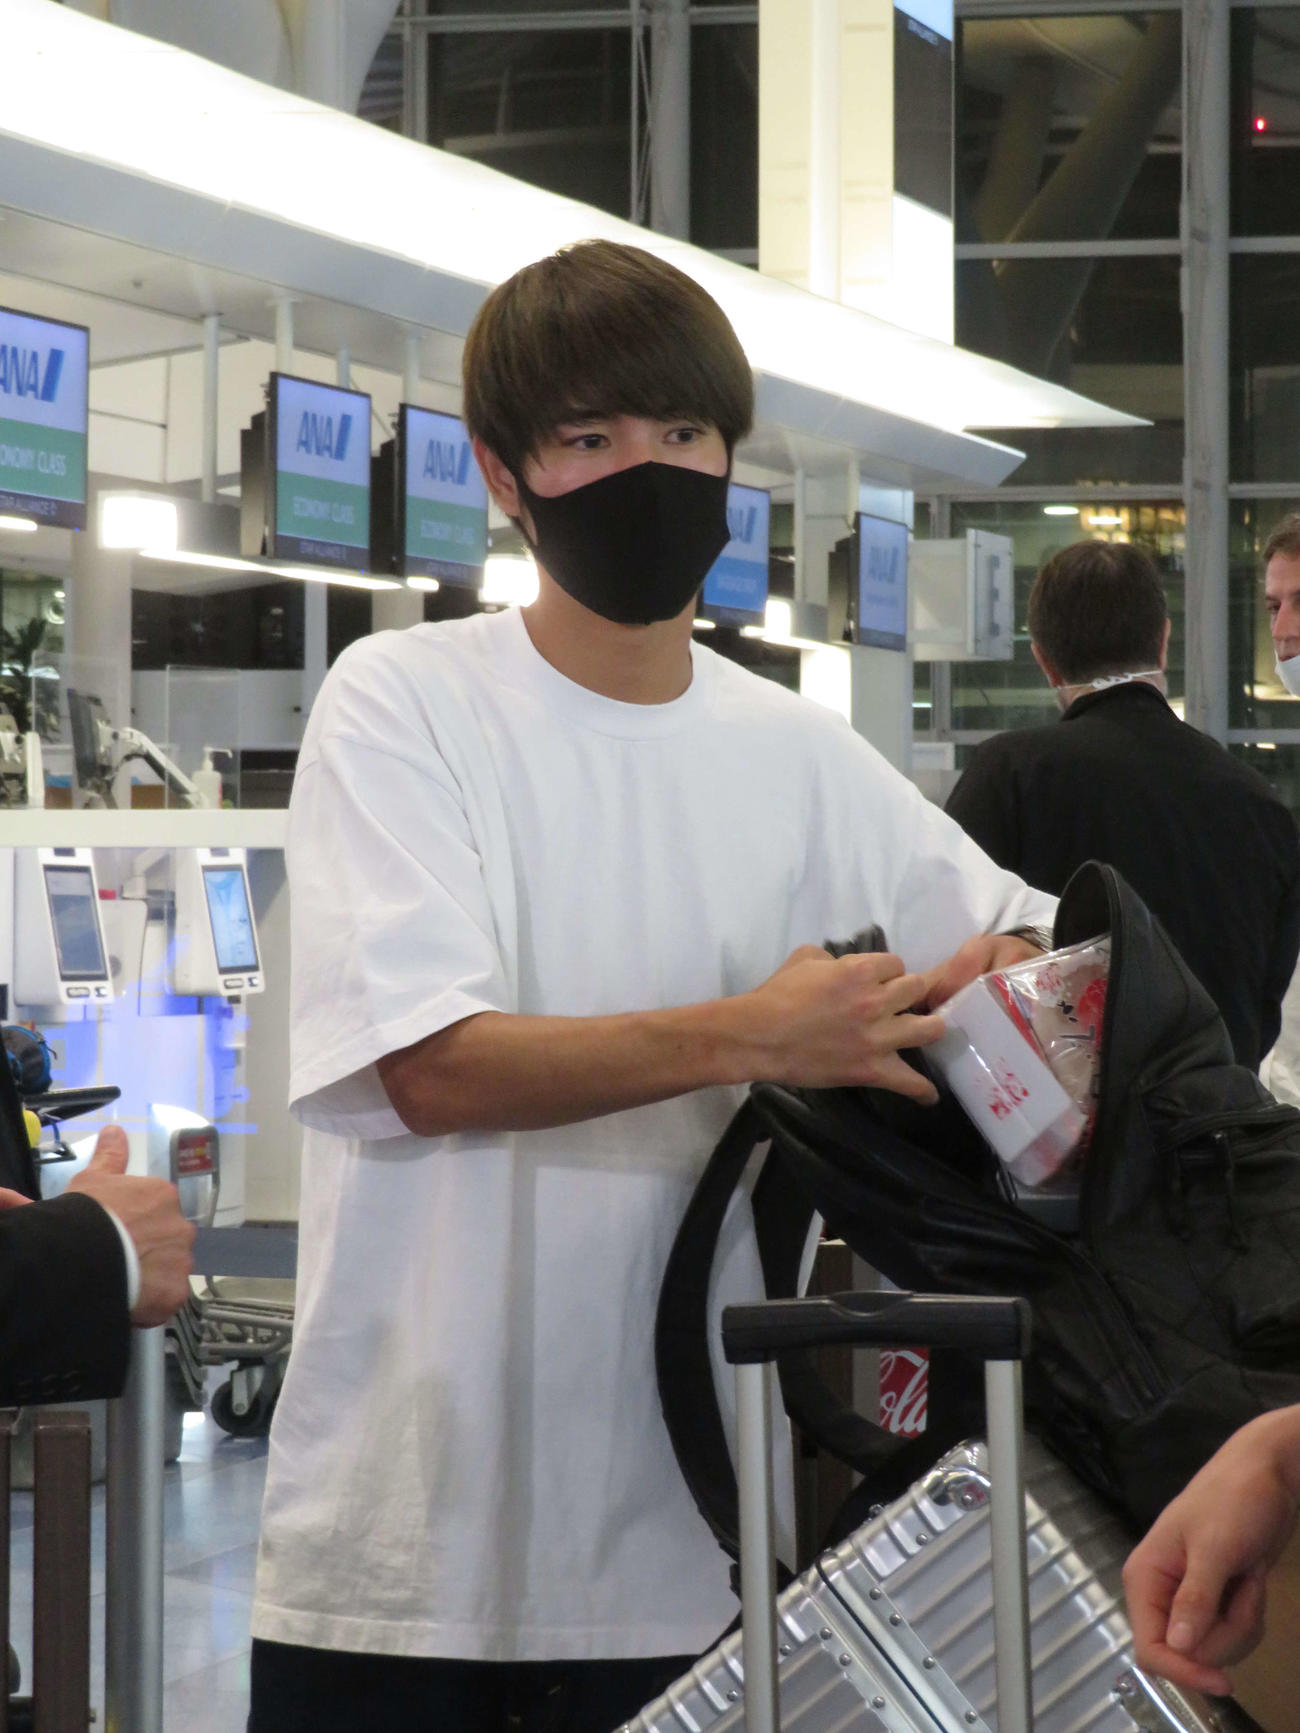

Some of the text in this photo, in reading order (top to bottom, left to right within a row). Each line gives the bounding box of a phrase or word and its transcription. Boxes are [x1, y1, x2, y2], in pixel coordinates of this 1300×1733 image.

[0, 344, 39, 400] ANA
[296, 411, 333, 459] ANA
[38, 451, 67, 476] CLASS
[423, 439, 456, 484] ANA
[880, 1350, 929, 1433] ola
